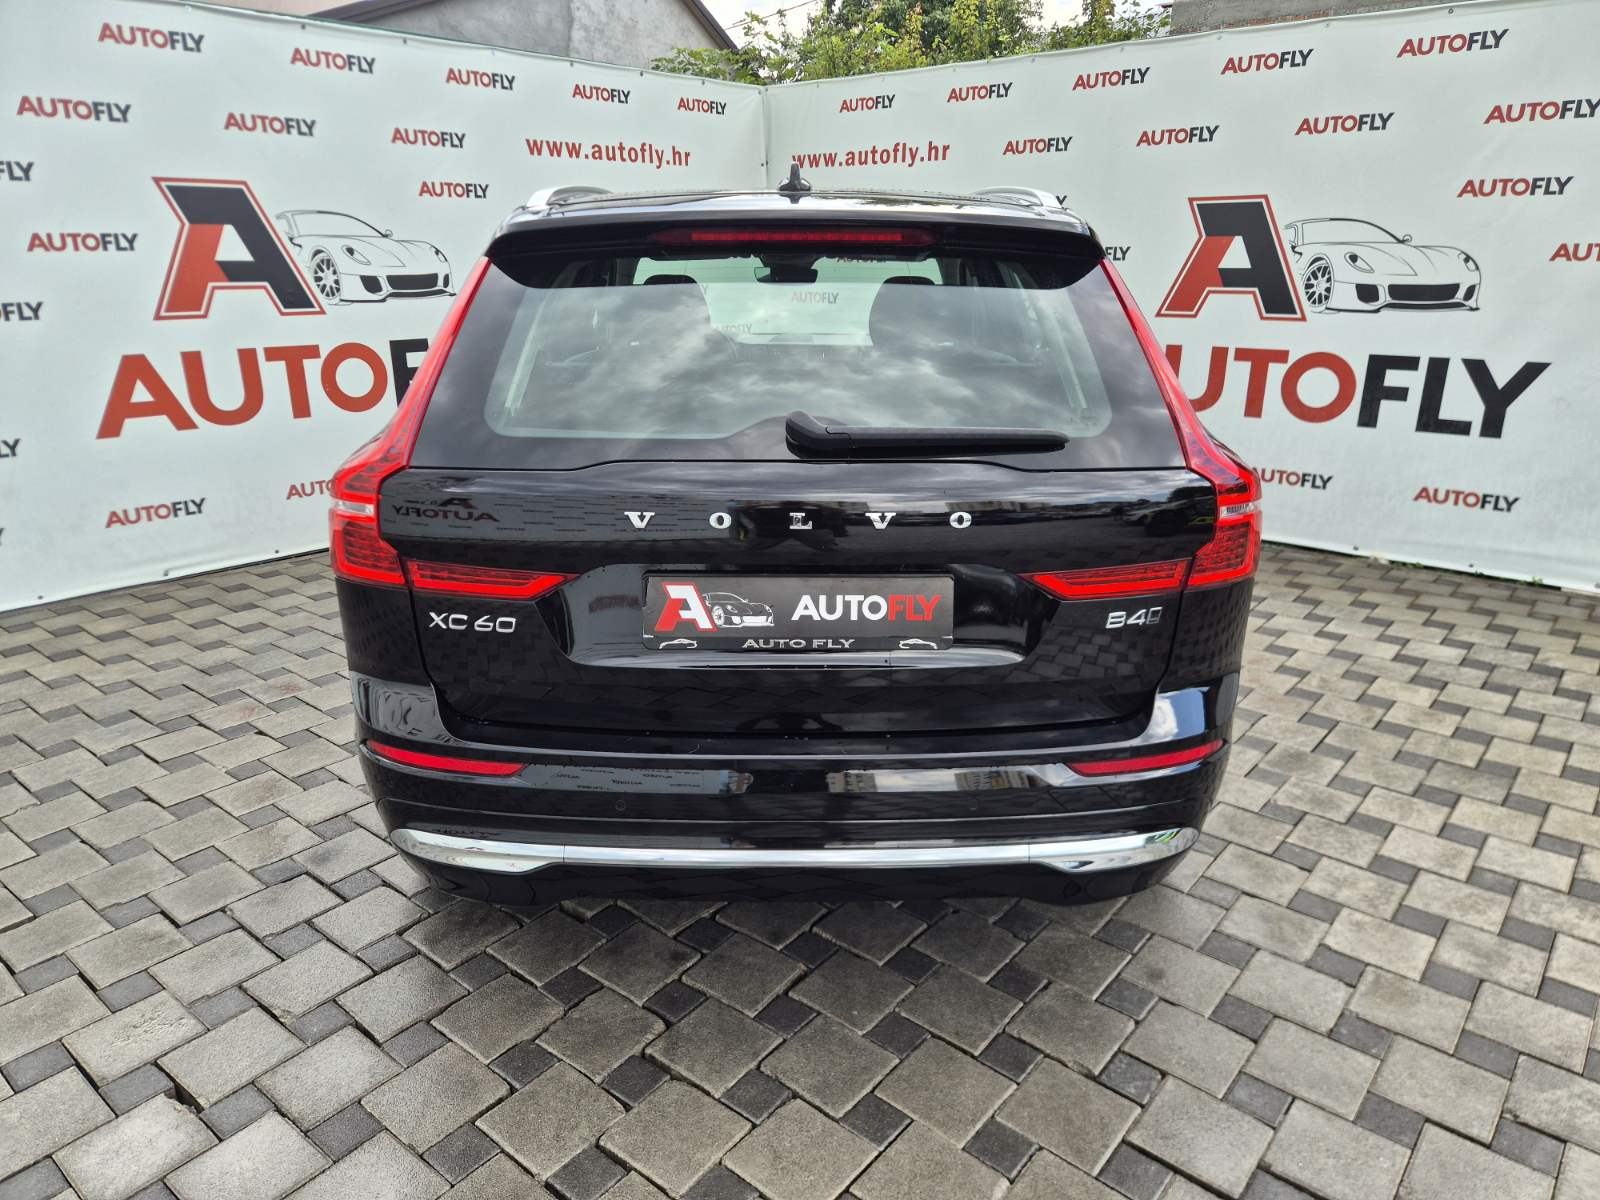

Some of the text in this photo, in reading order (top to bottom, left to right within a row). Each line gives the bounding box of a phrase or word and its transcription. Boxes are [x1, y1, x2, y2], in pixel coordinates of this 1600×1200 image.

[98, 23, 205, 53] AUTOFLY
[1397, 29, 1510, 58] AUTOFLY
[291, 48, 376, 74] AUTOFLY
[1221, 49, 1314, 75] AUTOFLY
[446, 67, 516, 91] AUTOFLY
[1072, 66, 1151, 91] AUTOFLY
[572, 83, 631, 105] AUTOFLY
[840, 94, 896, 114] AUTOFLY
[947, 82, 1013, 103] AUTOFLY
[17, 96, 131, 123] AUTOFLY
[677, 97, 727, 115] AUTOFLY
[1484, 98, 1600, 125] AUTOFLY
[224, 112, 317, 137] AUTOFLY
[1136, 125, 1219, 147] AUTOFLY
[1295, 112, 1395, 136] AUTOFLY
[392, 127, 466, 149] AUTOFLY
[1003, 136, 1073, 156] AUTOFLY
[525, 138, 691, 169] www.autofly.hr
[792, 140, 950, 168] www.autofly.hr
[419, 181, 489, 199] AUTOFLY
[1457, 176, 1574, 198] AUTOFLY
[27, 233, 138, 252] AUTOFLY
[1413, 487, 1520, 512] AUTOFLY
[106, 498, 205, 528] AUTOFLY
[791, 594, 942, 622] AUTOFLY
[742, 638, 855, 649] AUTO FLY
